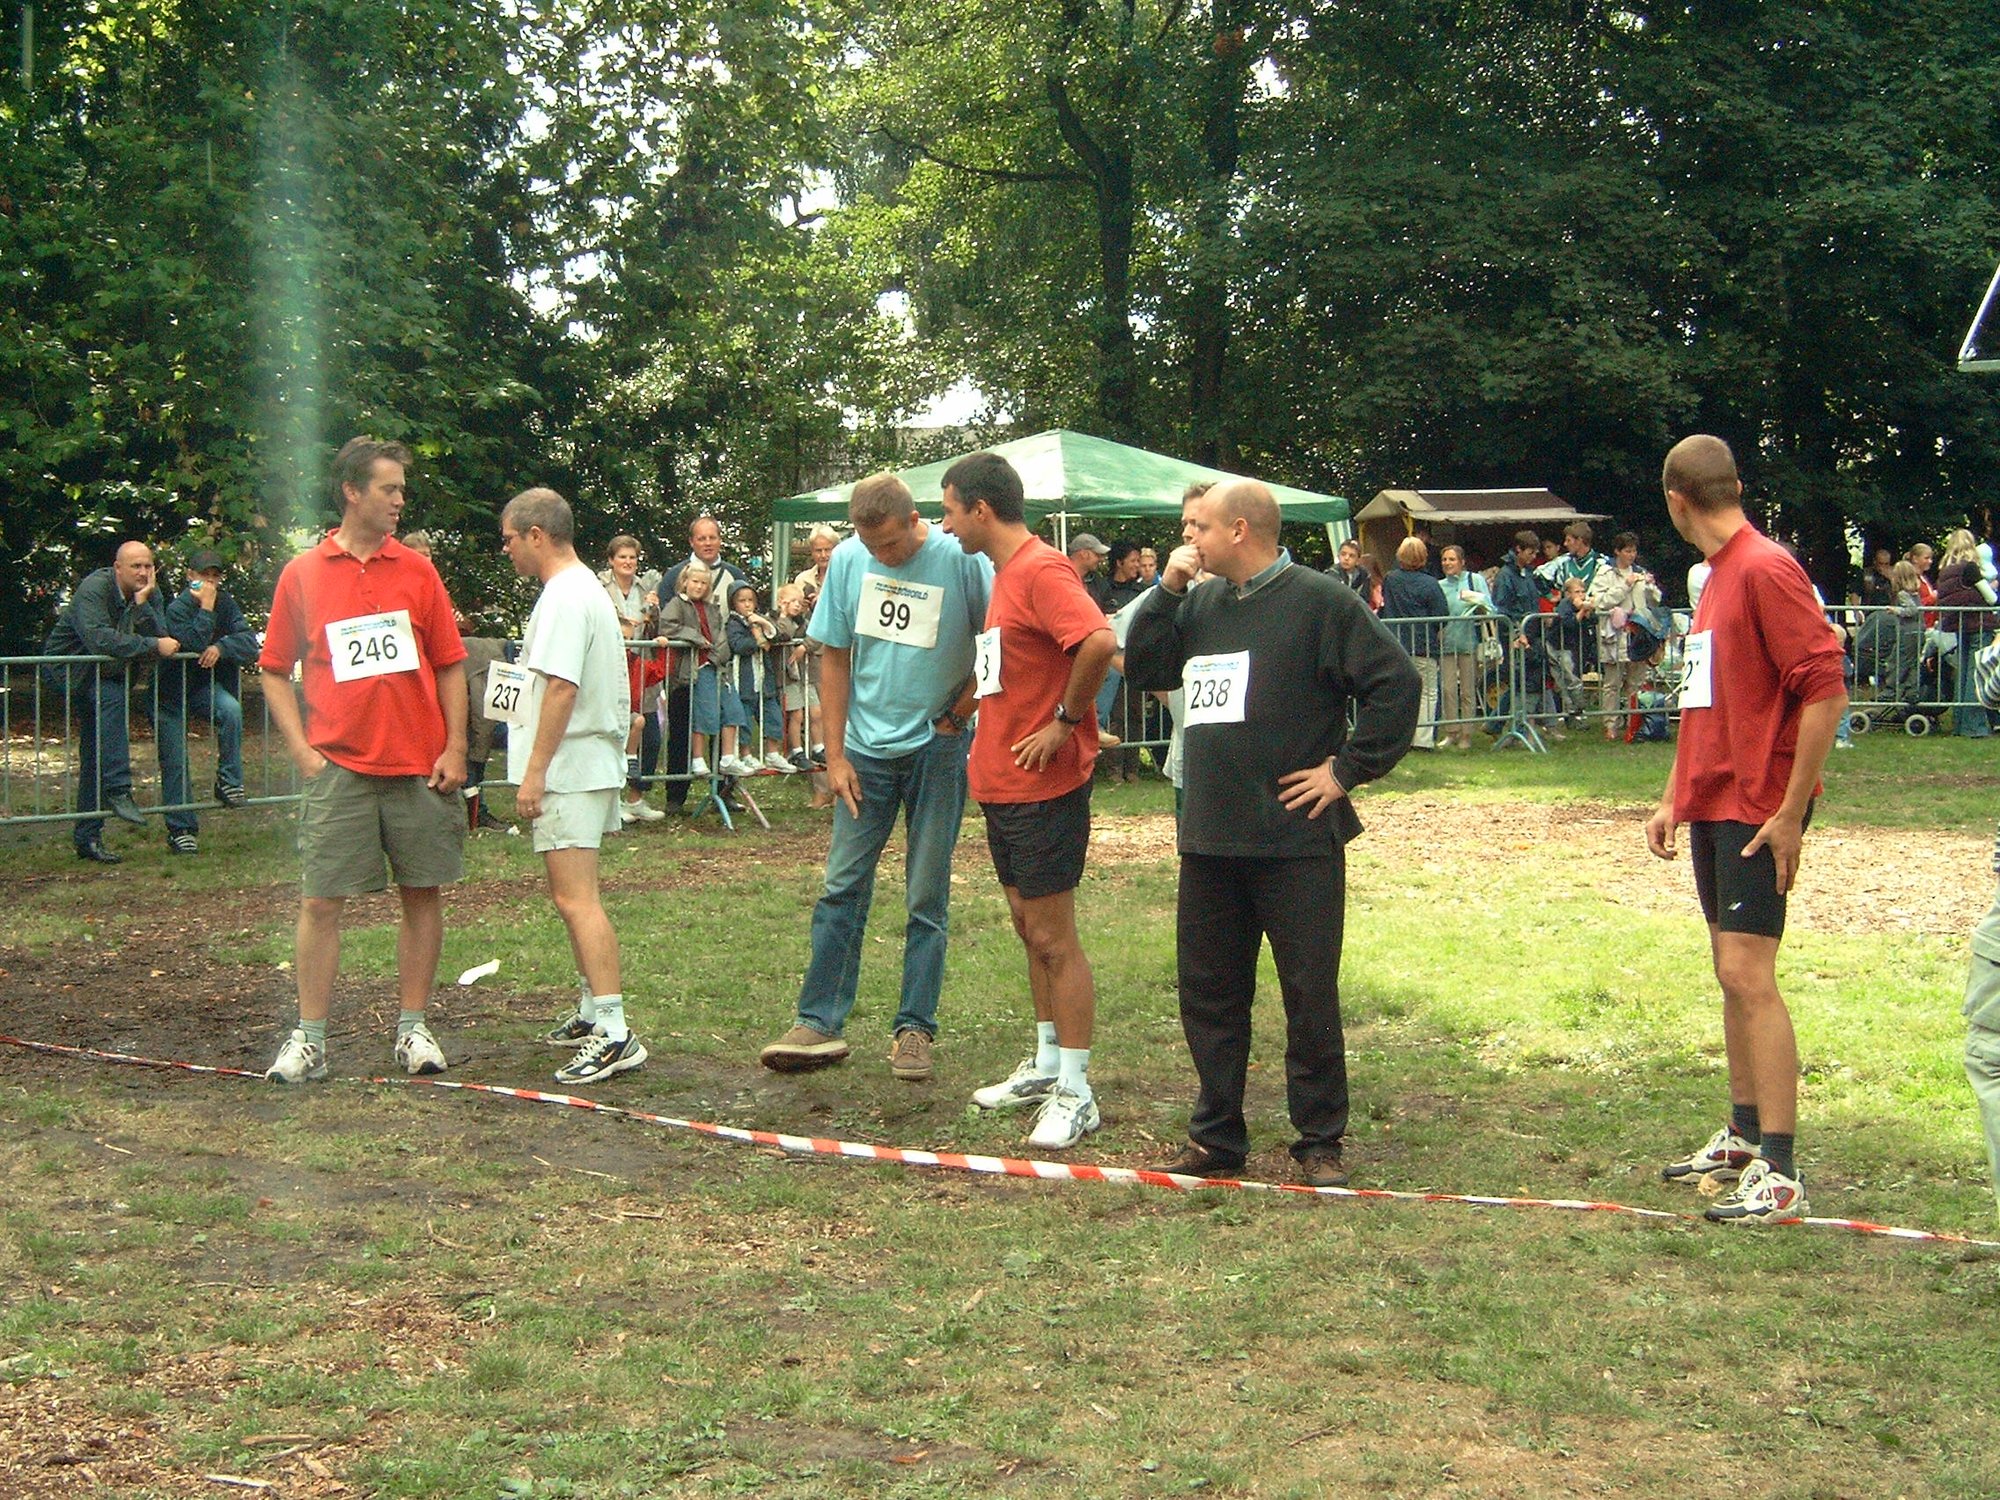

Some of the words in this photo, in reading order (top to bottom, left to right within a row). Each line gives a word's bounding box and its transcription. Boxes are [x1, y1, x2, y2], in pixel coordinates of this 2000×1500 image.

[879, 600, 911, 630] 99
[348, 634, 398, 667] 246
[491, 683, 521, 712] 237
[1190, 678, 1231, 710] 238
